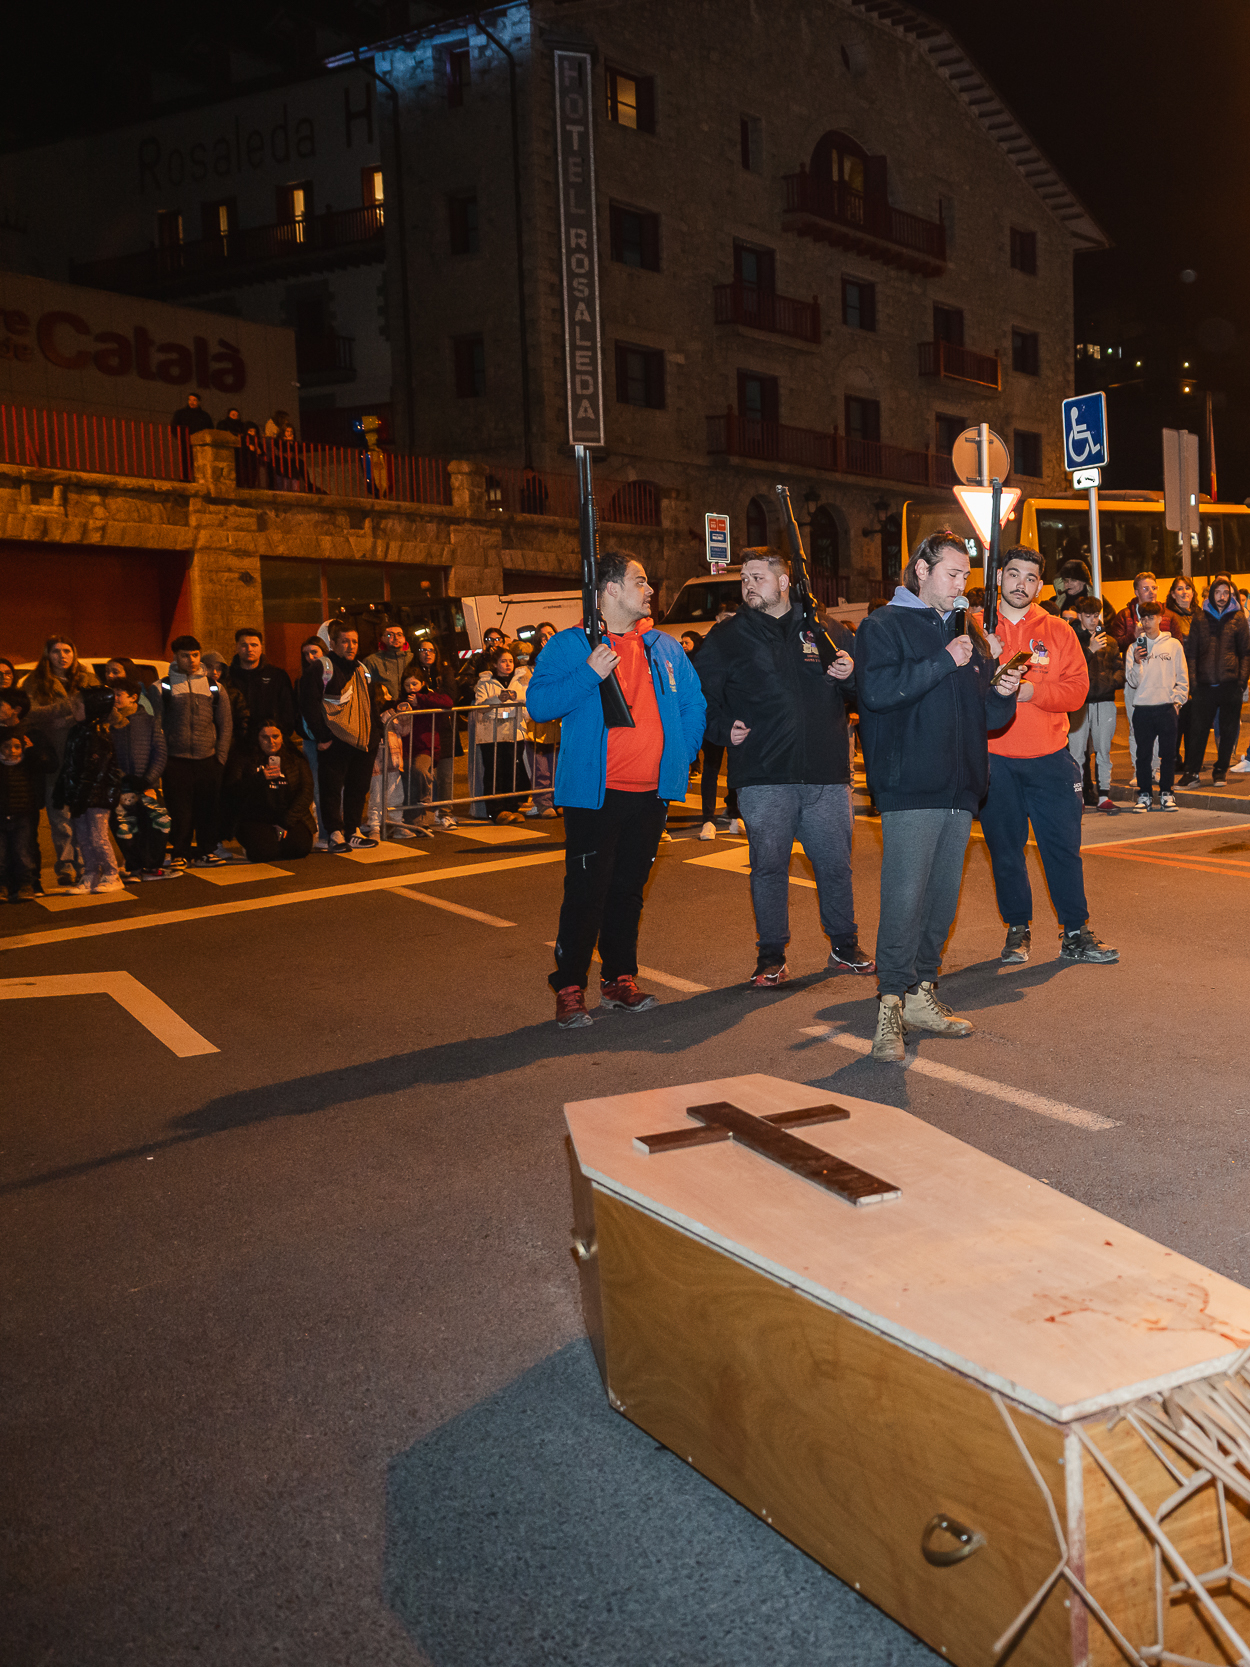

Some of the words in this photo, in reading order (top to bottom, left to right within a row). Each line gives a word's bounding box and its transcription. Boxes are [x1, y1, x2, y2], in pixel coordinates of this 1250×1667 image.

[138, 102, 317, 195] Rosaleda
[563, 60, 587, 215] HOTEL
[36, 310, 246, 394] Català
[570, 228, 596, 420] ROSALEDA
